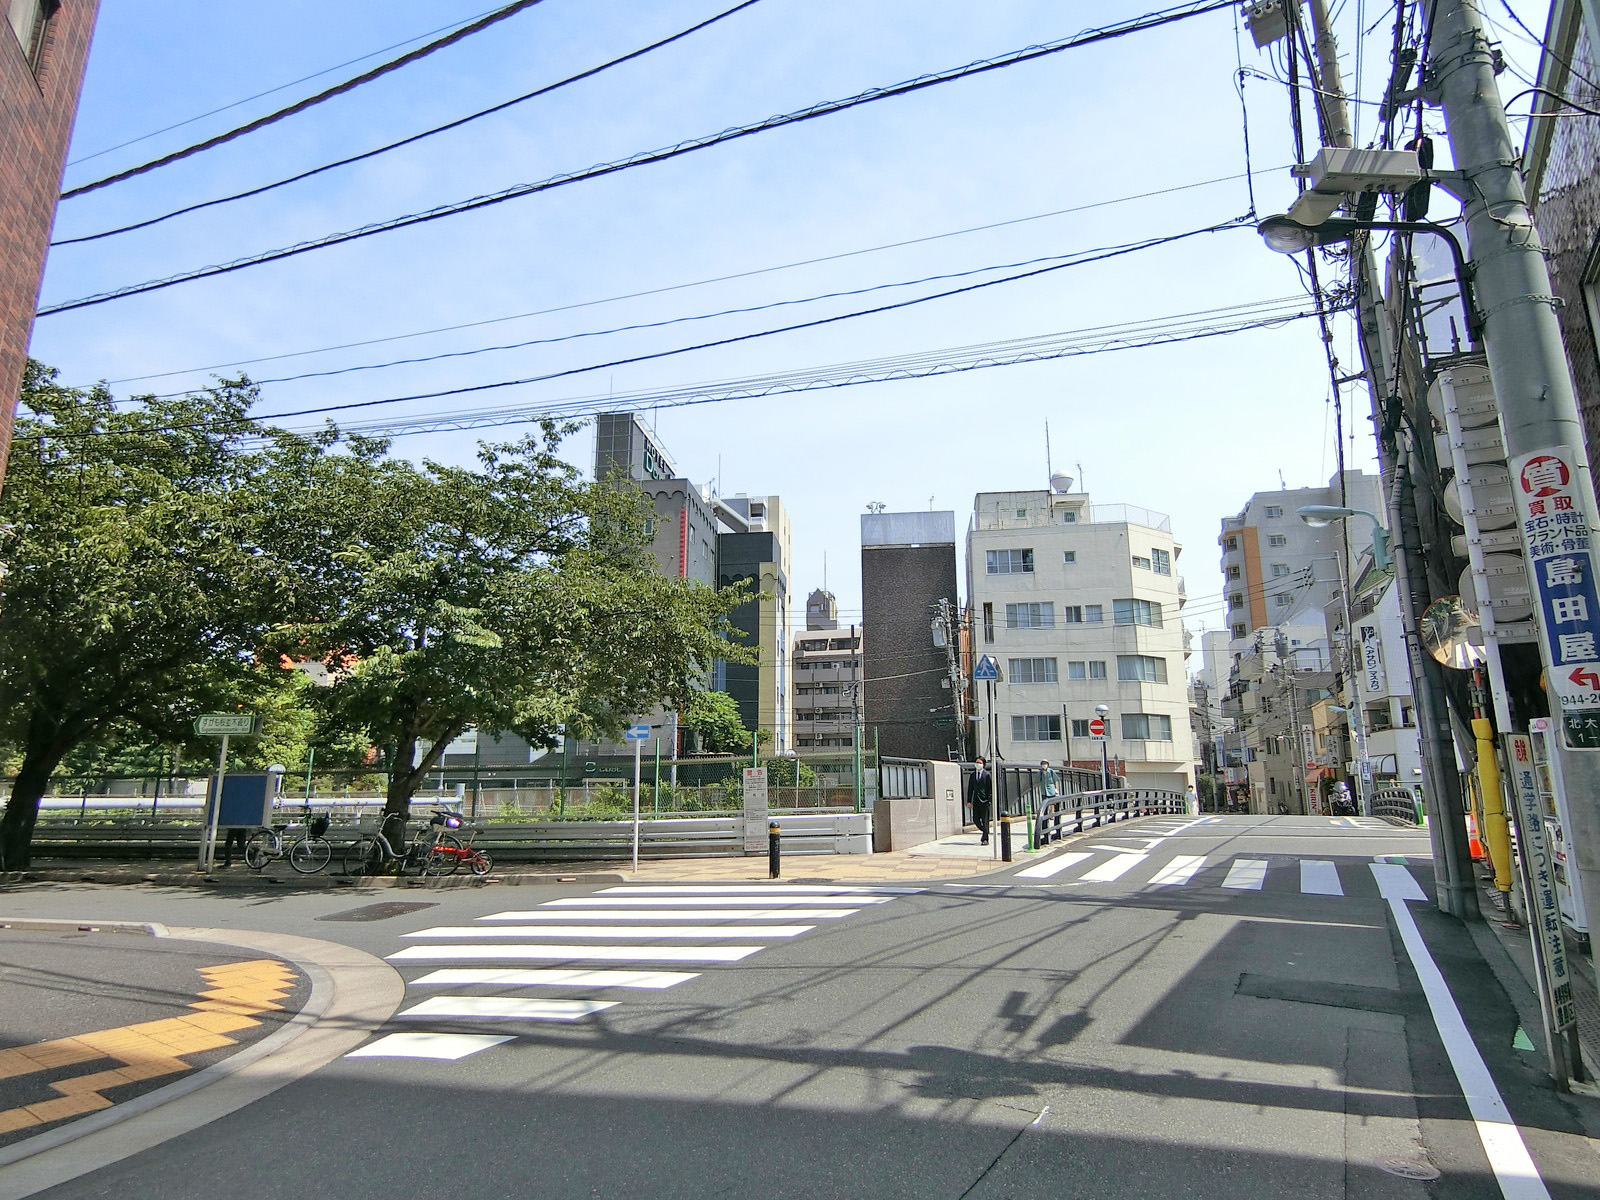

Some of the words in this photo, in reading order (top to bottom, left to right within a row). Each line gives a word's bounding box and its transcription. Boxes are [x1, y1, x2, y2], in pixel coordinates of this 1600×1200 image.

[1522, 458, 1568, 497] 質
[1528, 496, 1575, 518] 買取
[1524, 511, 1585, 533] 宝石・時計
[1527, 524, 1589, 545] ブランド品
[1545, 557, 1599, 663] 島田屋
[1560, 693, 1600, 706] 944-2
[1568, 718, 1598, 729] 北大
[1309, 788, 1317, 809] KIRIN
[1519, 770, 1566, 978] 通学路につき運転注意
